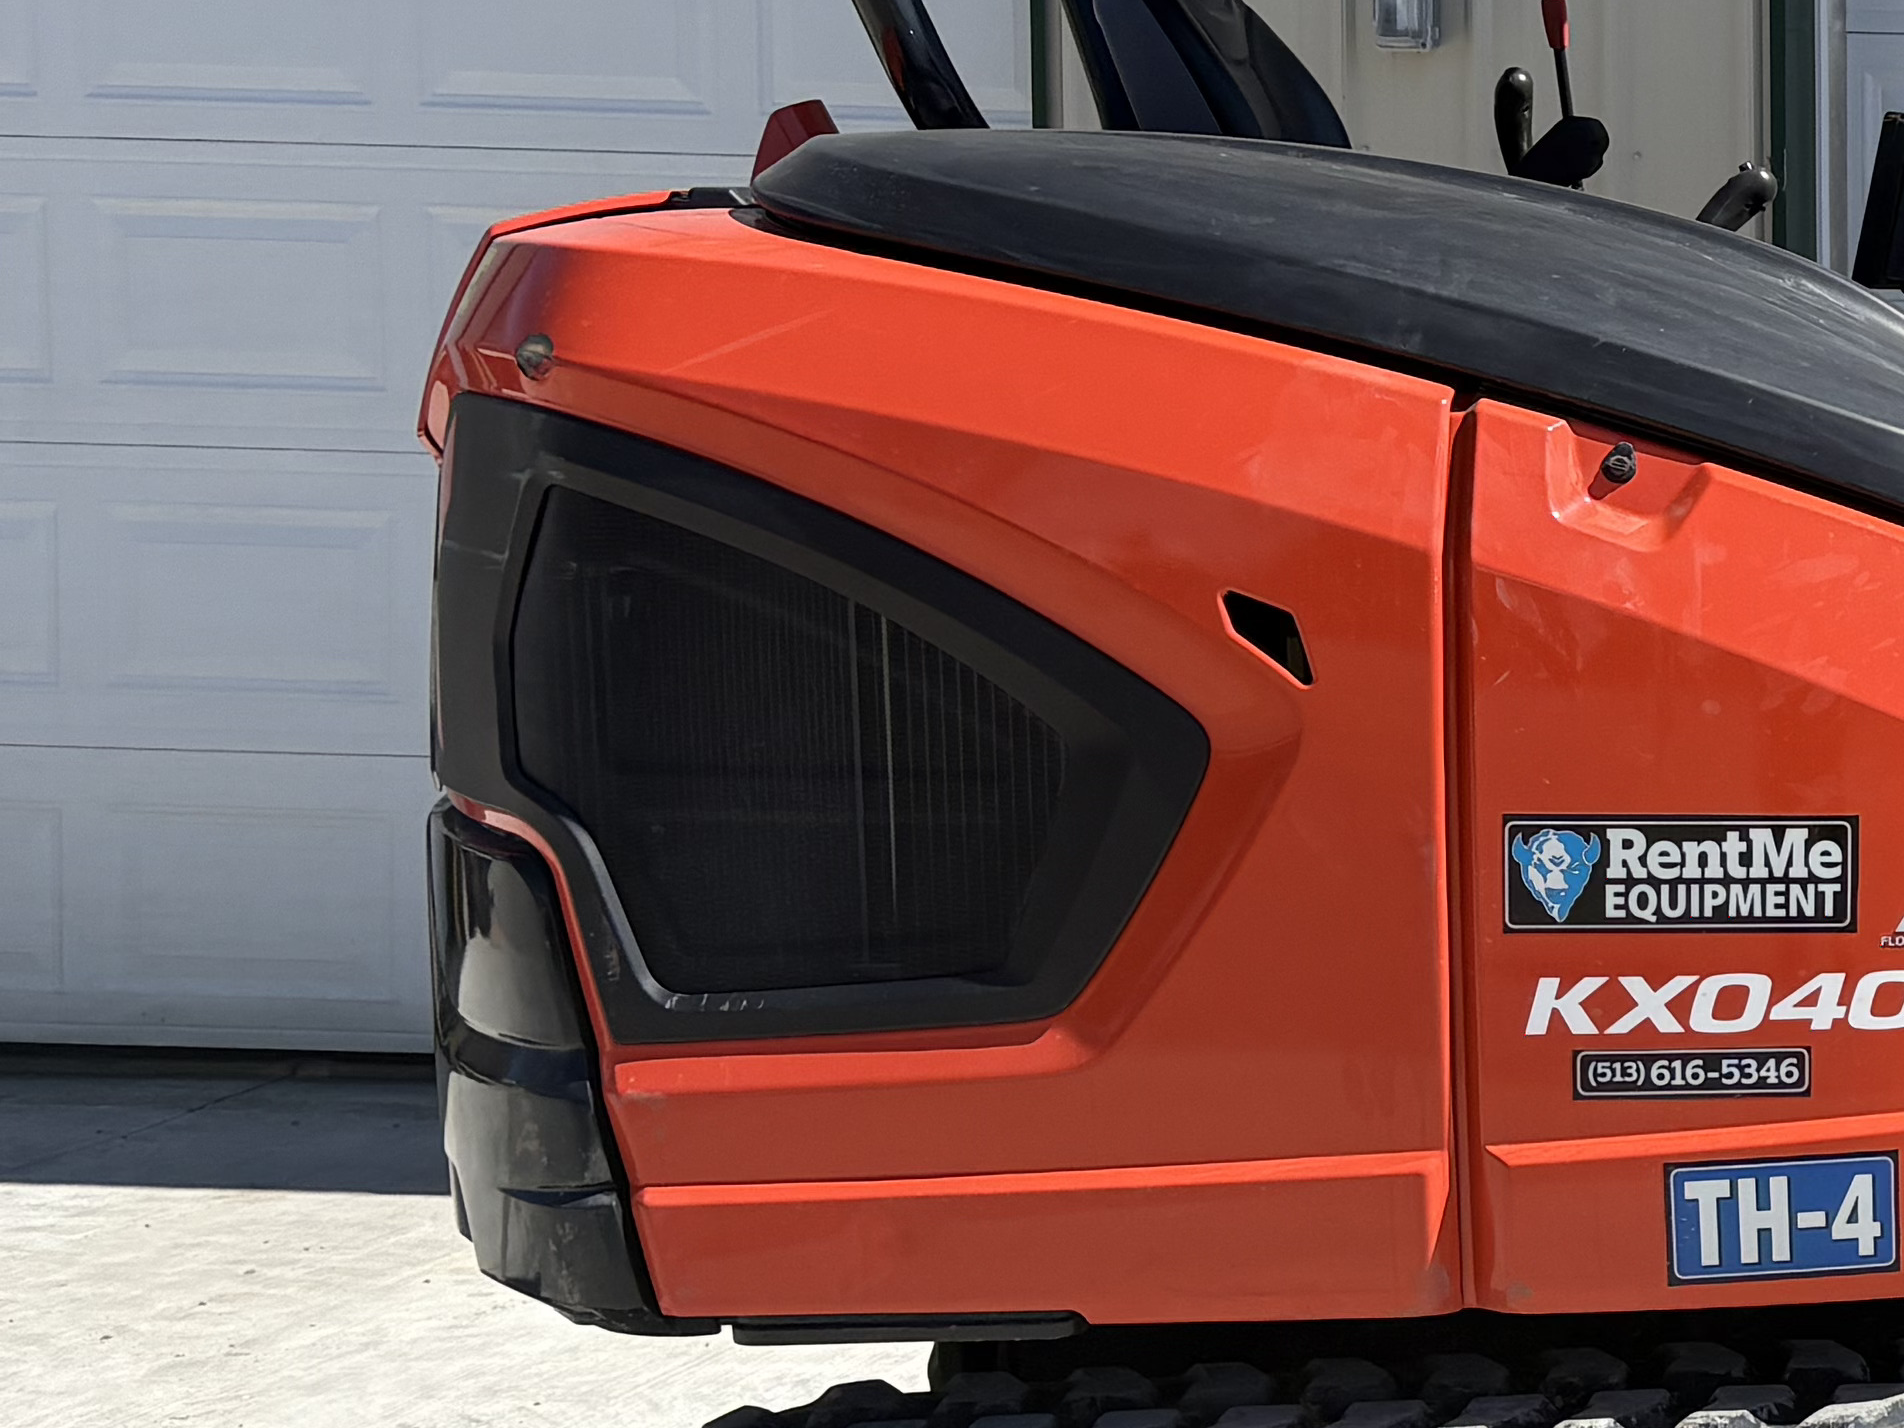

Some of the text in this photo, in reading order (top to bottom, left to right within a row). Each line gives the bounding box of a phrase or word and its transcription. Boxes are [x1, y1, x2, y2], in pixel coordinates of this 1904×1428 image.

[1606, 827, 1843, 880] RentMe
[1605, 882, 1841, 924] EQUIPMENT
[1588, 1057, 1800, 1087] (513) 616-5346
[1683, 1173, 1882, 1268] TH-4
